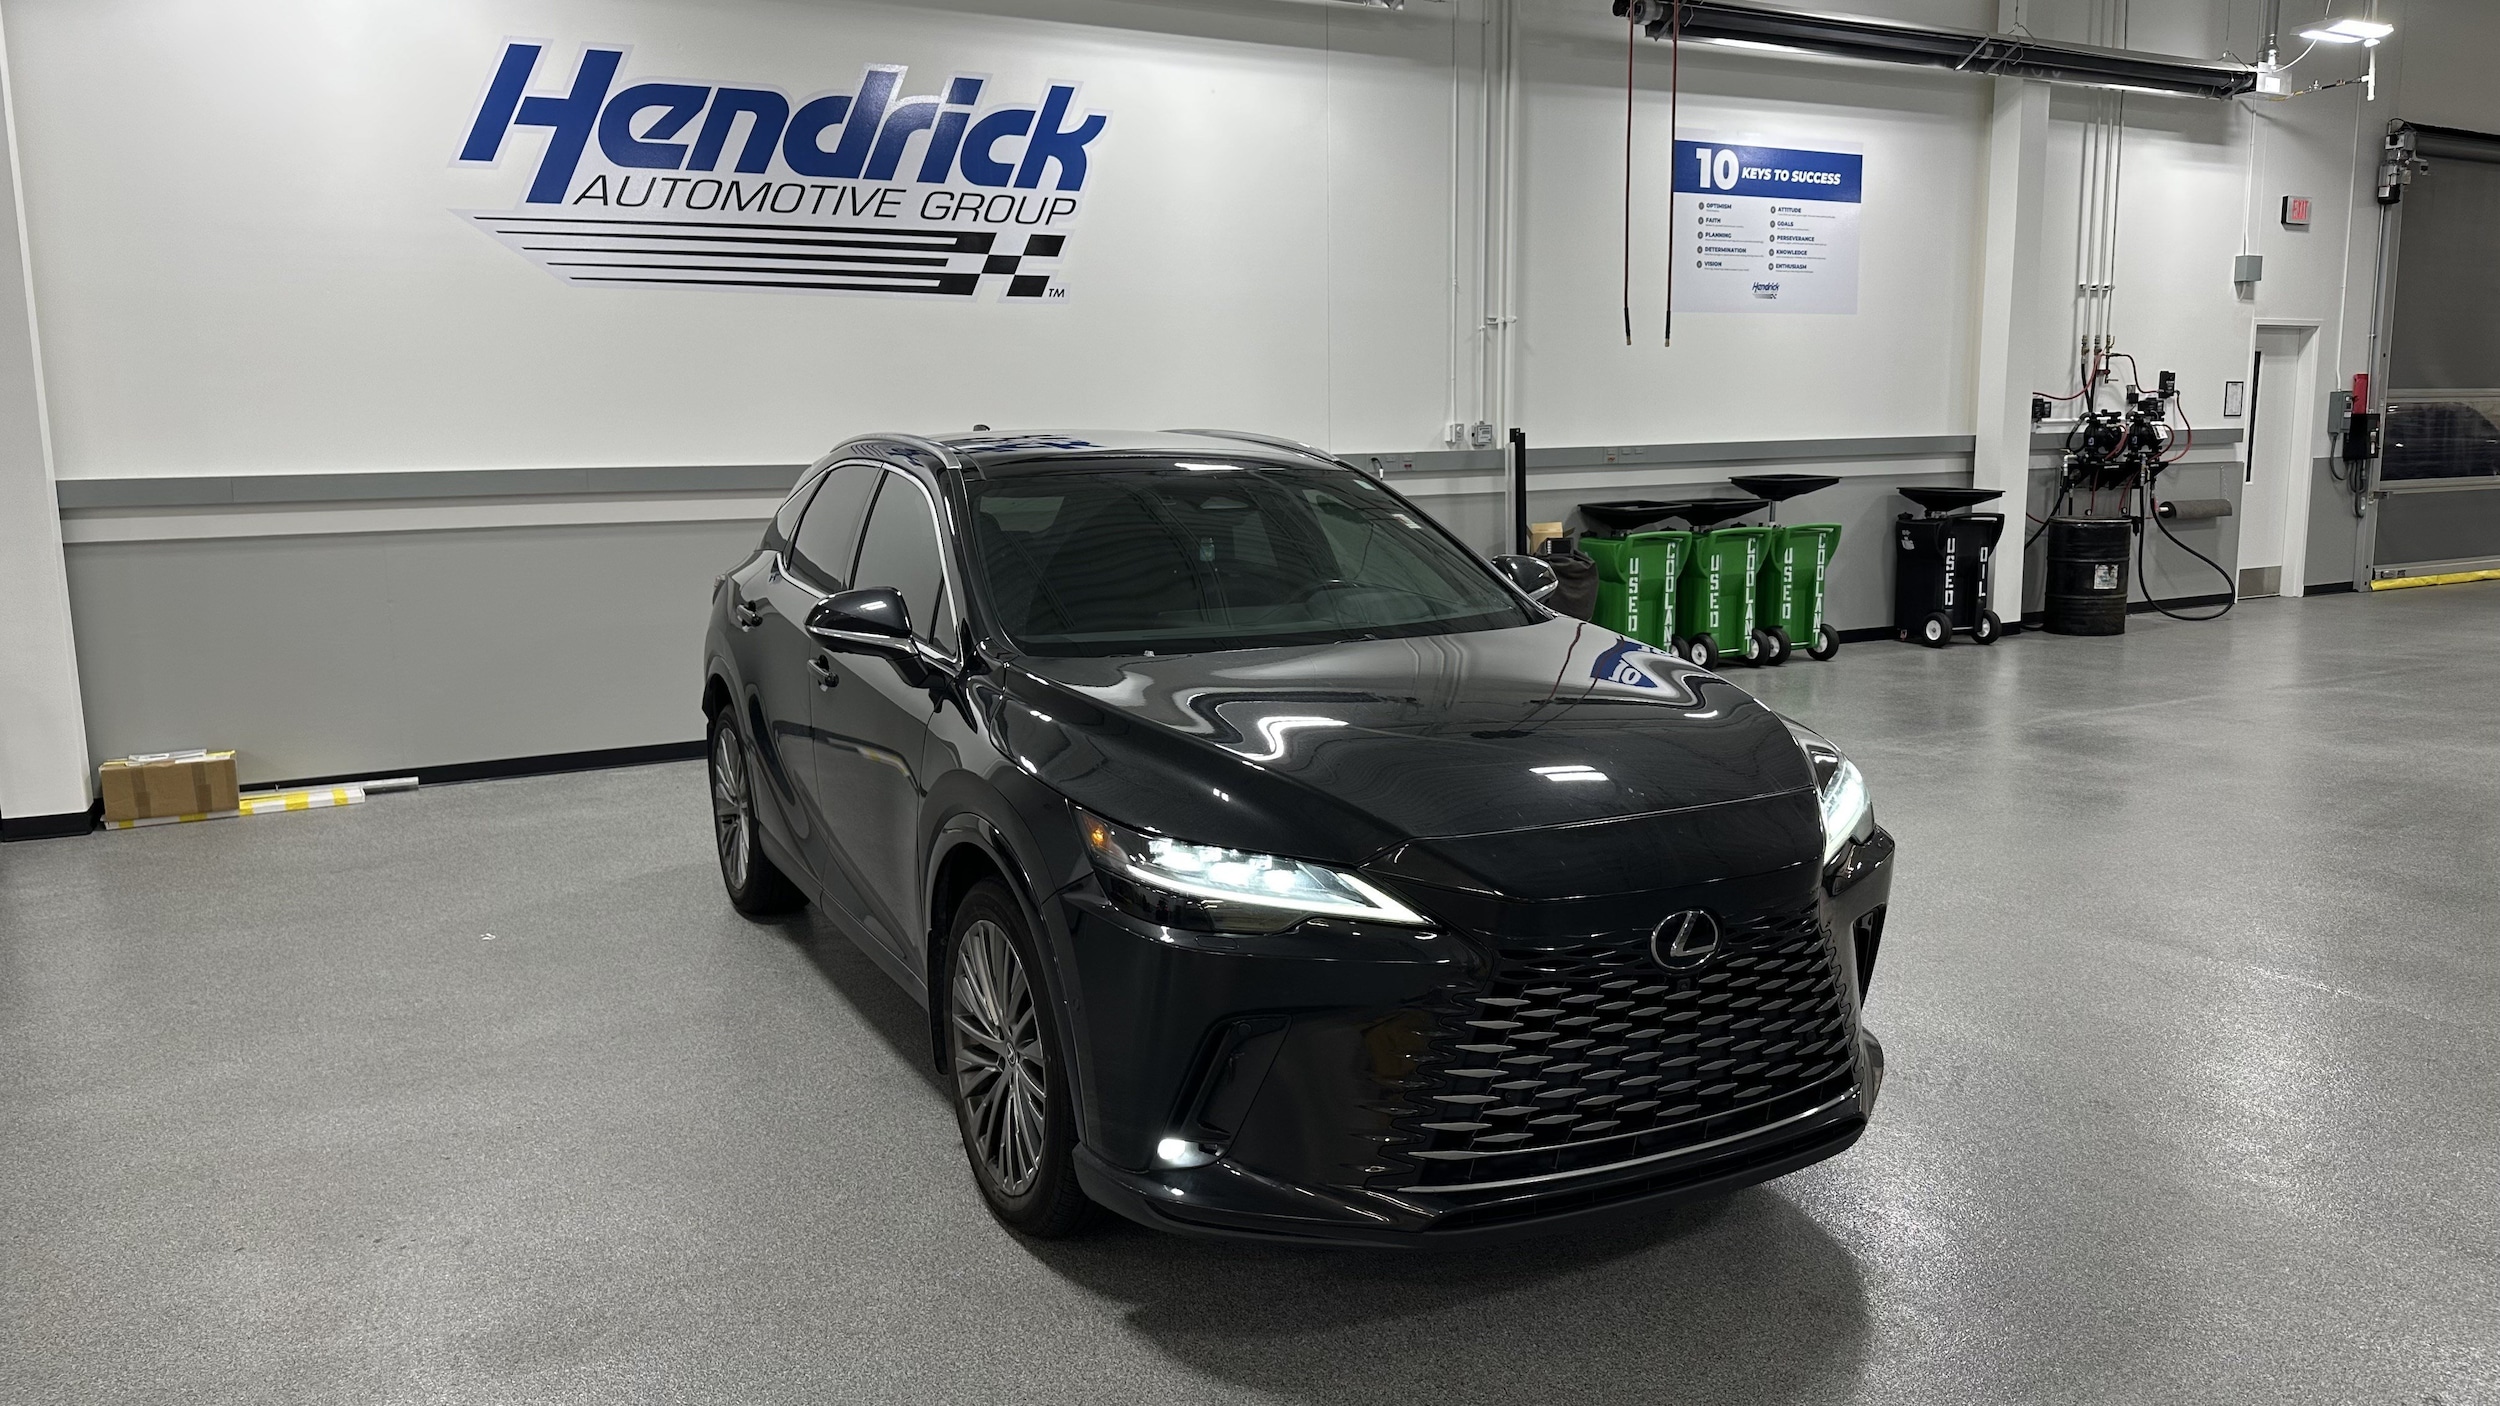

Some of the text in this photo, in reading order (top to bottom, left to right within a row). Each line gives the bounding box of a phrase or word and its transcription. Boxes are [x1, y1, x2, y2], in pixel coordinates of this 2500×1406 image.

[459, 43, 1107, 204] Hendrick
[1696, 147, 1842, 190] 10 KEYS TO SUCCESS
[572, 174, 1077, 226] AUTOMOTIVE GROUP
[1704, 246, 1747, 254] DETERMINATION
[1048, 287, 1066, 299] TM
[1752, 281, 1780, 293] Hendrick
[1628, 542, 1676, 653] USED COOLANT
[1709, 537, 1756, 652] USED COOLANT
[1782, 532, 1827, 645] USED COOLANT
[1944, 537, 1989, 606] USED OIL
